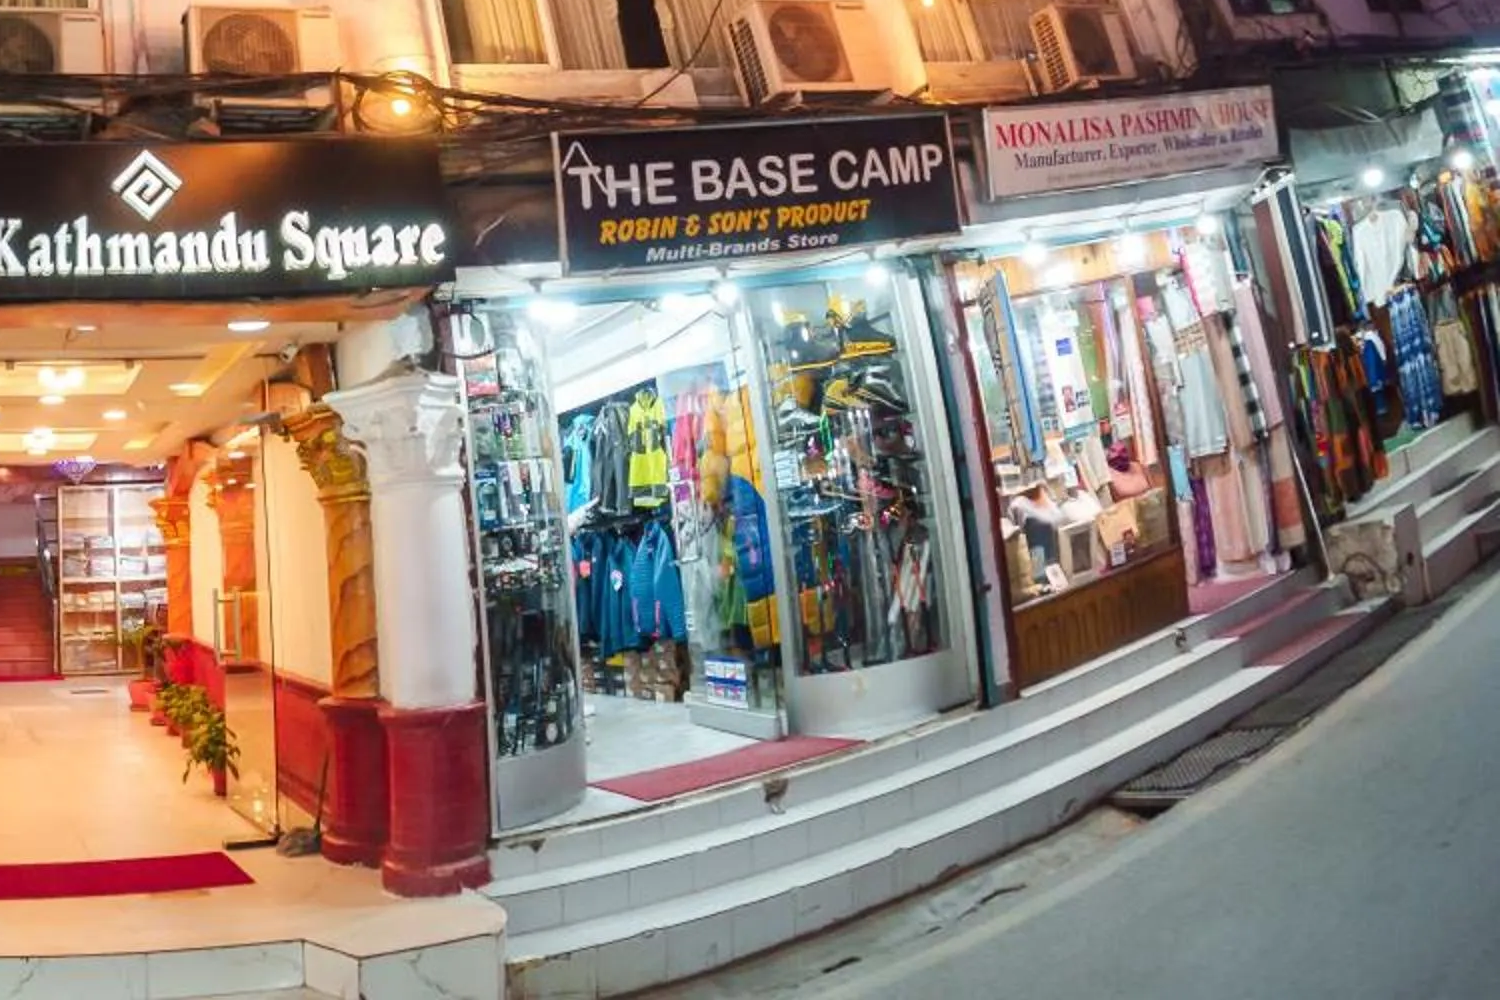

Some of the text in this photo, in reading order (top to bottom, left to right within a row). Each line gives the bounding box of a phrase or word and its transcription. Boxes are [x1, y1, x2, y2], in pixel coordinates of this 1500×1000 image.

[995, 116, 1116, 150] MONALISA
[566, 143, 944, 211] THE BASE CAMP
[600, 199, 871, 245] ROBIN & SON'S PRODUCT
[281, 211, 446, 280] Square
[645, 230, 840, 263] Multi-Brands Store
